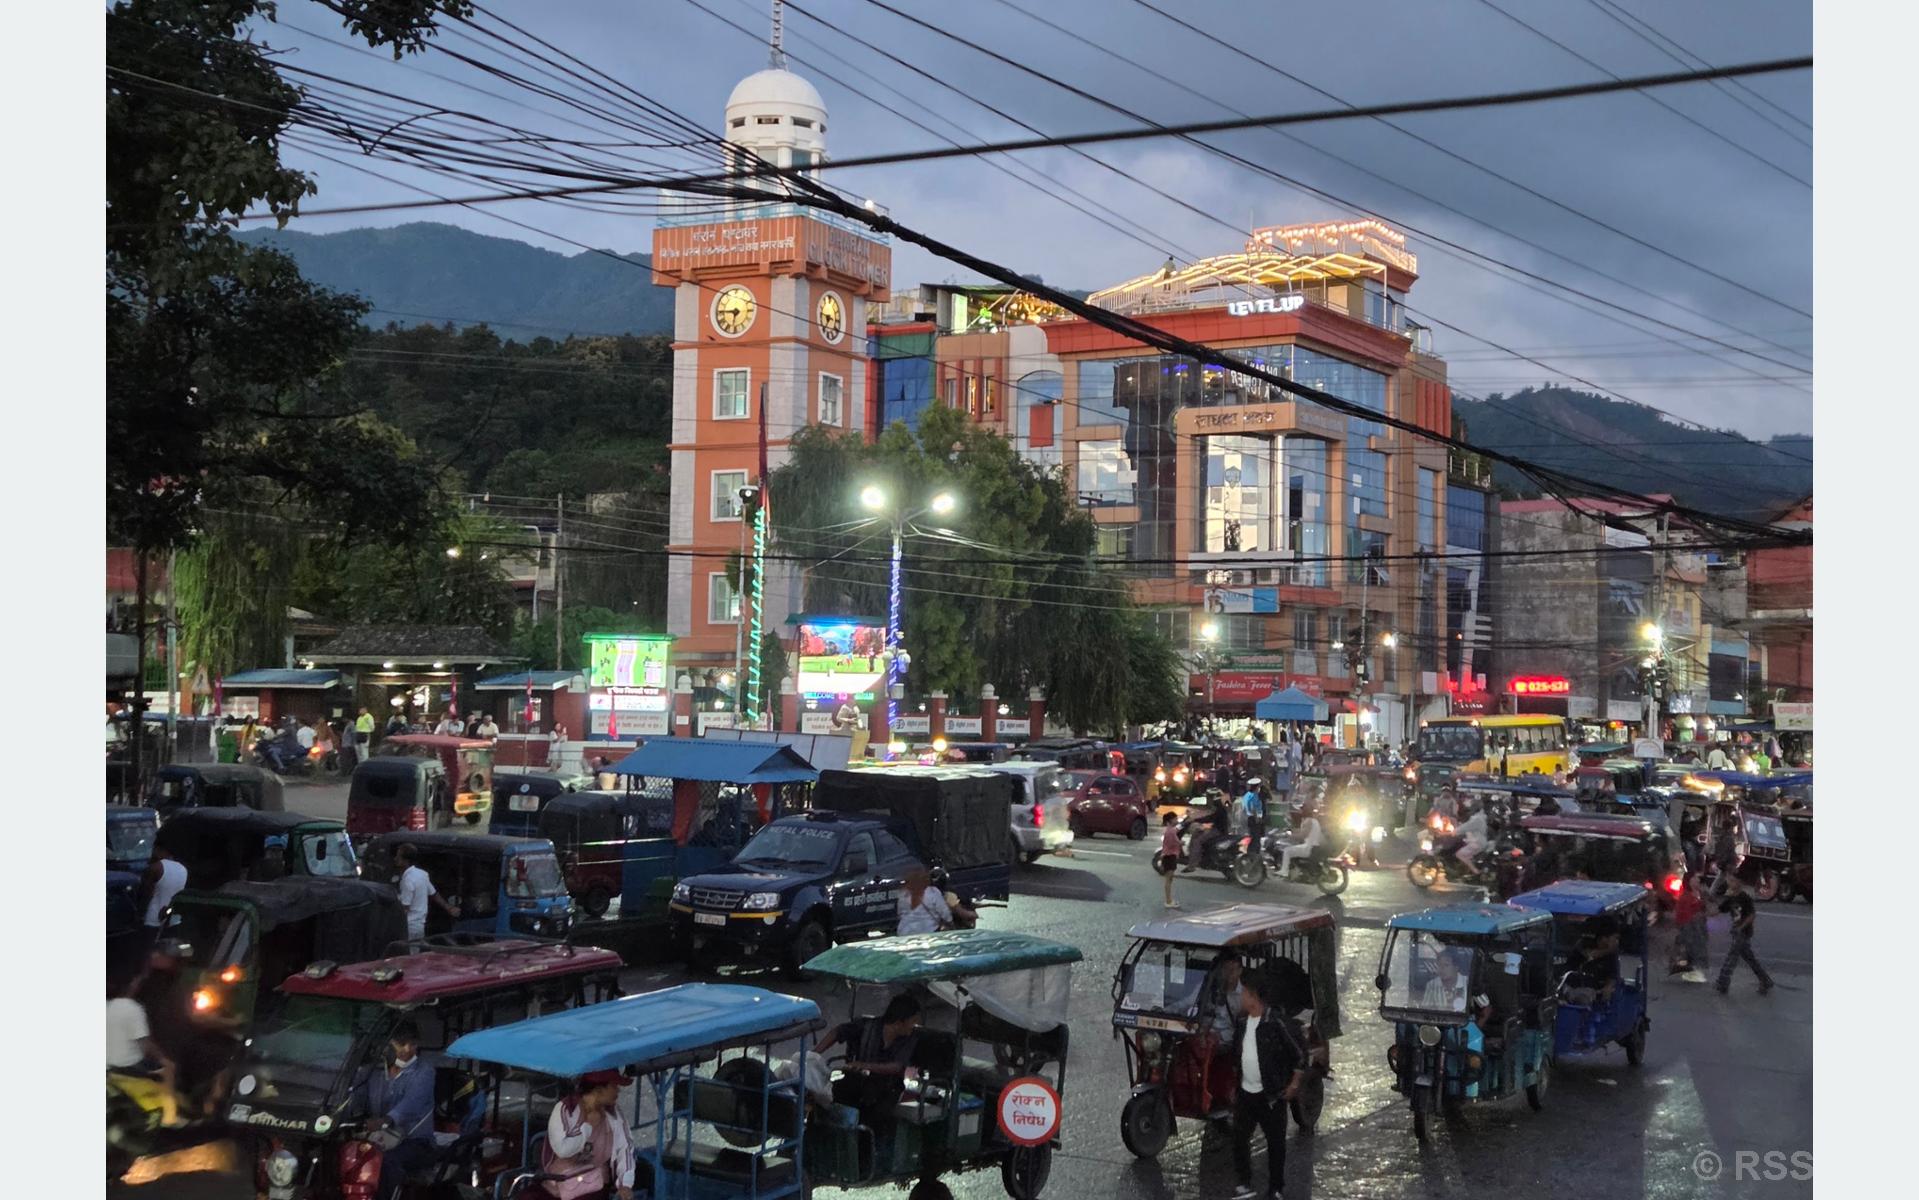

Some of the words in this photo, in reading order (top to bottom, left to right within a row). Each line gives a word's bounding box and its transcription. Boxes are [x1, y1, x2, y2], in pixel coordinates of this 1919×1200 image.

[808, 241, 848, 272] CLOCK
[852, 256, 888, 286] TOWER
[1228, 299, 1281, 316] LEVEL
[1281, 295, 1305, 312] UP
[1215, 680, 1246, 690] Fashion
[768, 825, 796, 835] NEPAL
[800, 828, 835, 839] POLICE
[1012, 1091, 1046, 1108] रोक्न
[1012, 1110, 1046, 1127] निषेध
